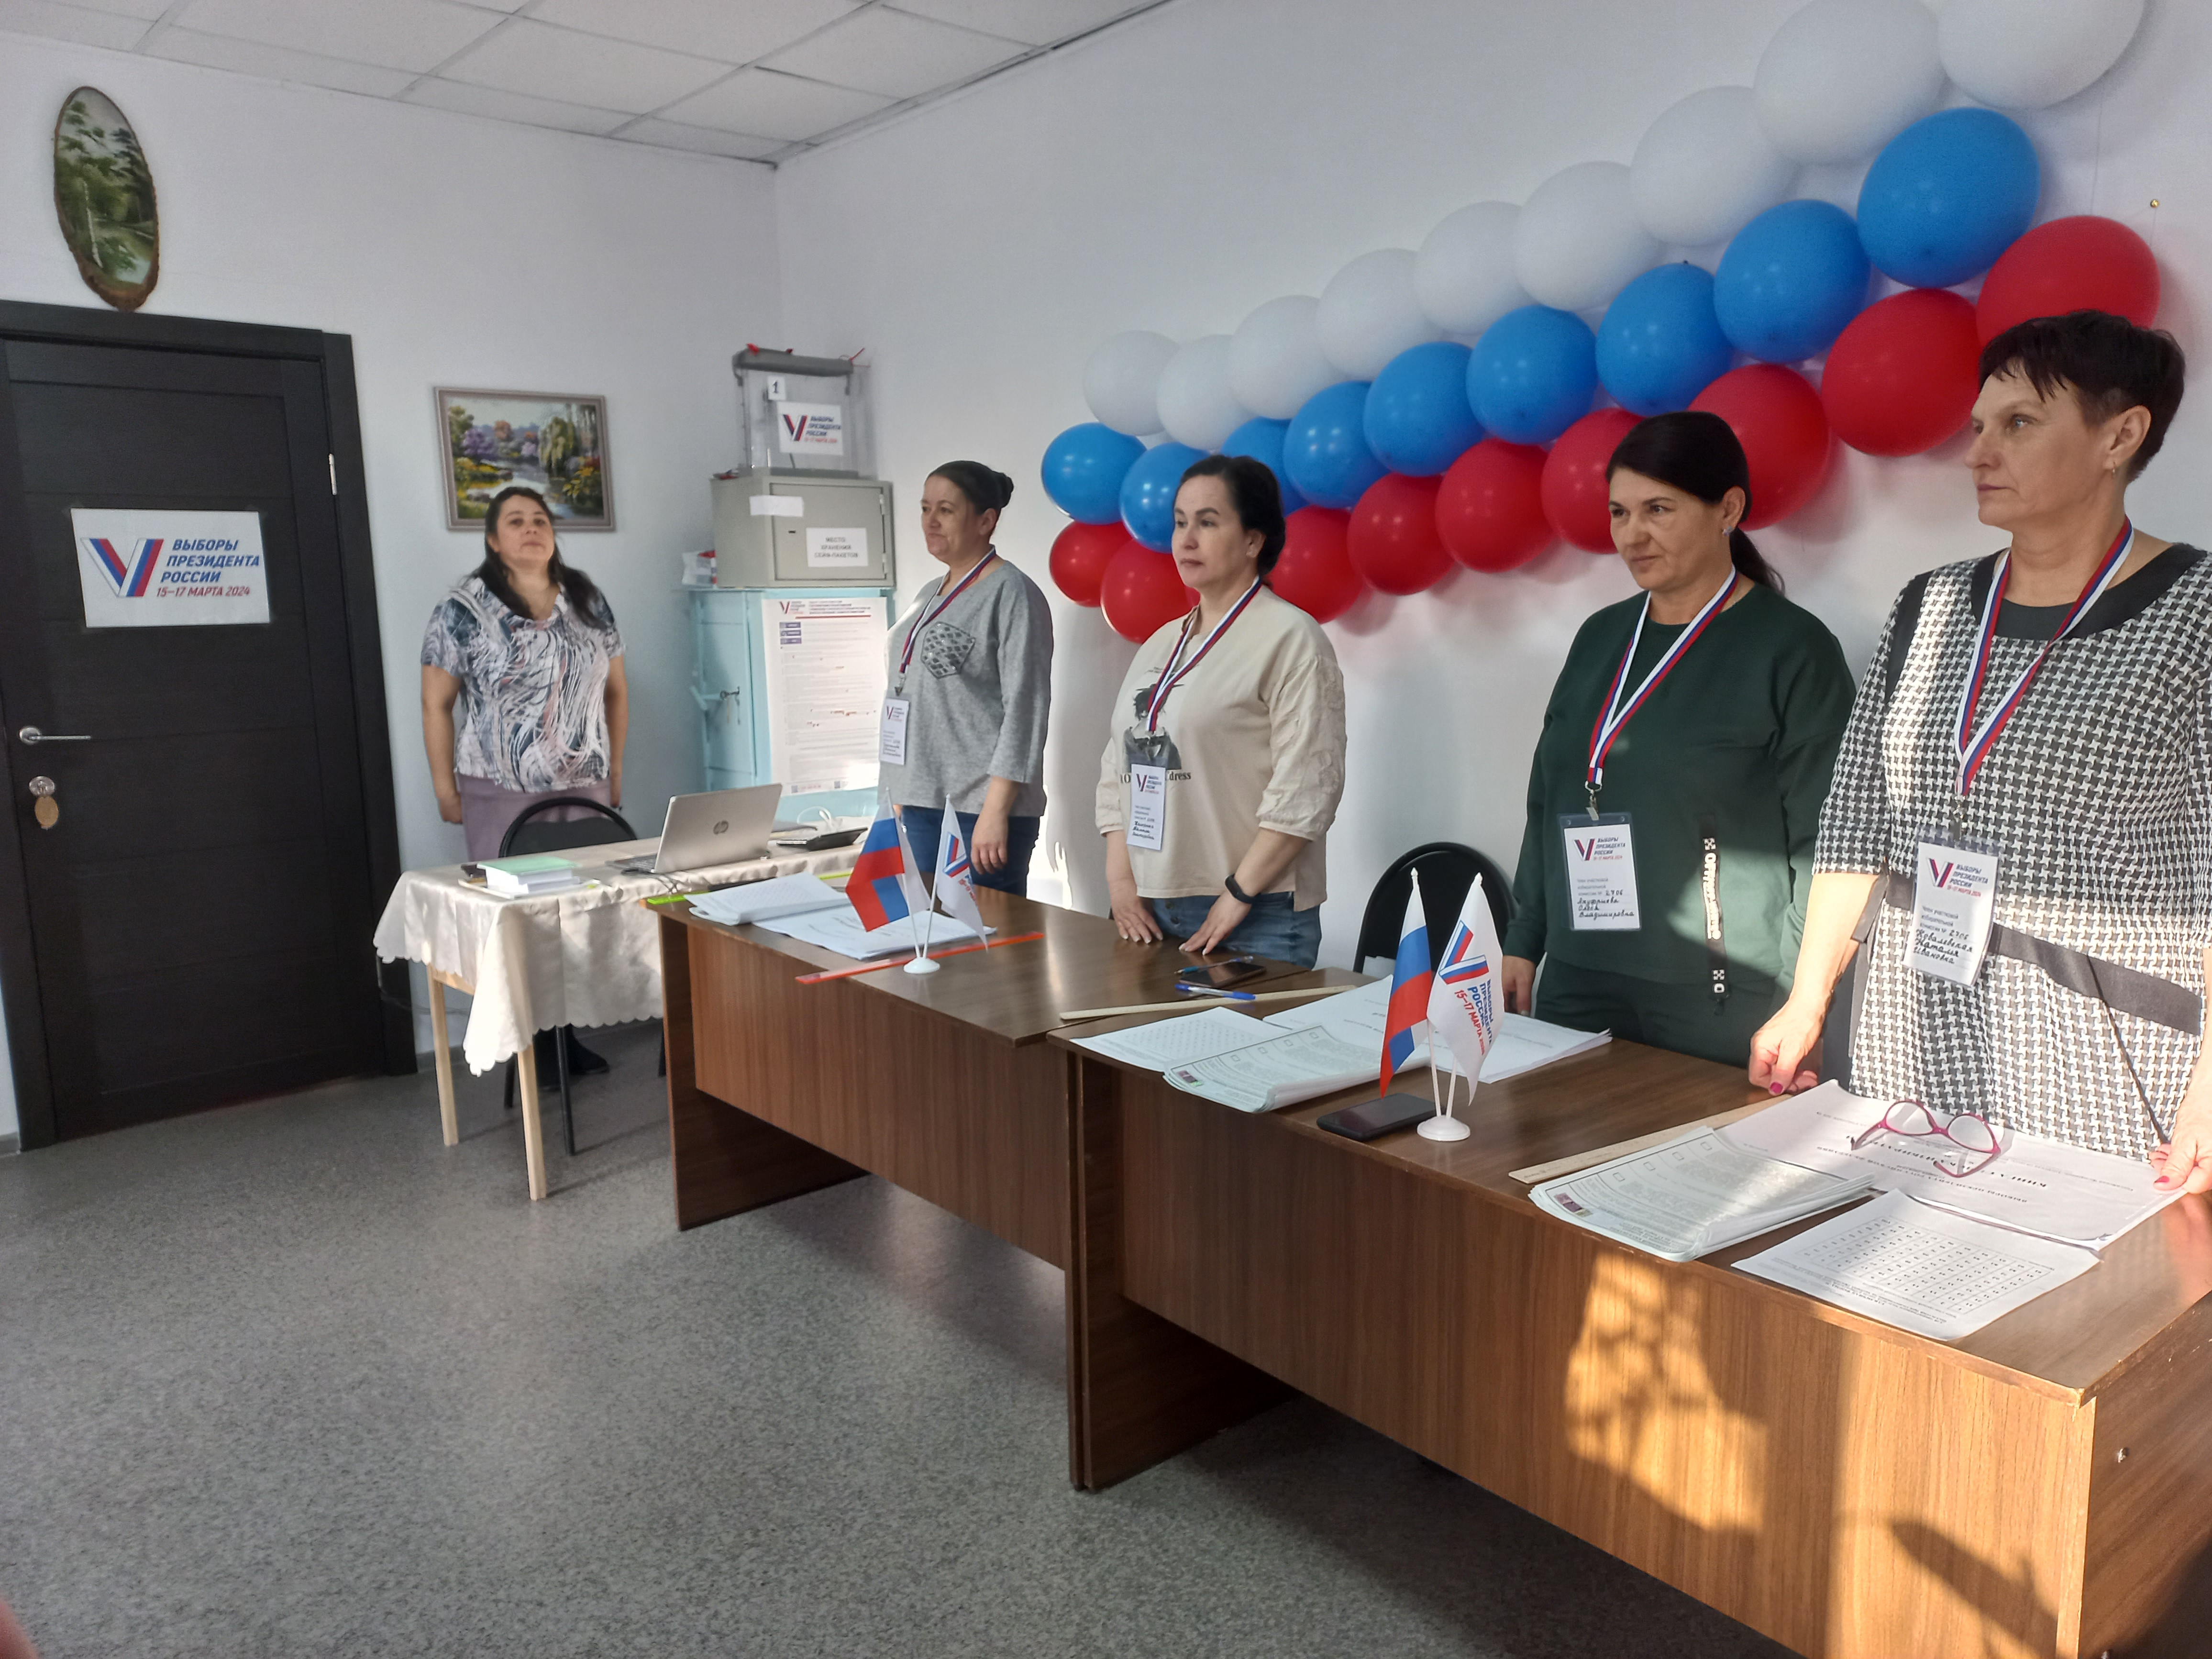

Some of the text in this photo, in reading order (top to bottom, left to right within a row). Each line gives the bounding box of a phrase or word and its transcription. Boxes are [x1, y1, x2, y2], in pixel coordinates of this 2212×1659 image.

[772, 380, 779, 394] 1
[172, 539, 239, 551] ВЫБОРЫ
[166, 555, 259, 568] ПРЕЗИДЕНТА
[160, 571, 221, 583] РОССИИ
[187, 586, 223, 597] МАРТА
[225, 586, 250, 597] 2024
[1956, 864, 1982, 874] ВЫБОРЫ
[1949, 878, 1972, 888] РОССИИ
[1953, 871, 1988, 884] ПРЕЗИДЕНТА
[1467, 986, 1484, 1027] РОССИИ
